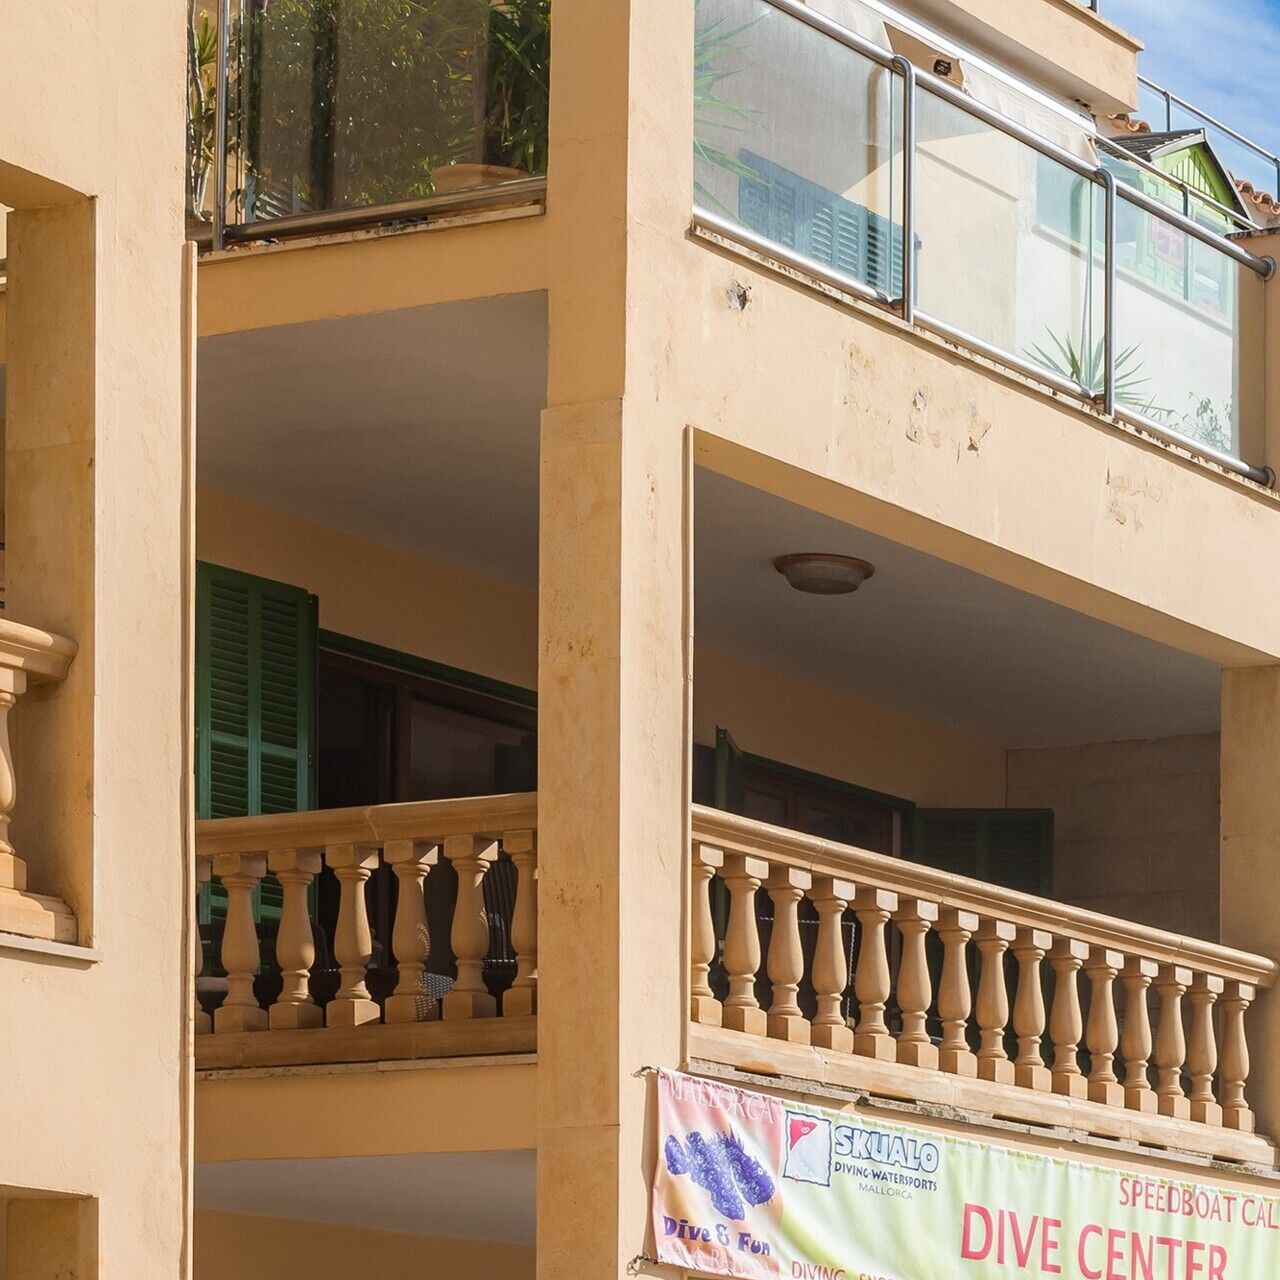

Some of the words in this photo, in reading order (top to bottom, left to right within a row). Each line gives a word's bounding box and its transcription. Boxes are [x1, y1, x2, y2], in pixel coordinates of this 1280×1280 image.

[834, 1125, 940, 1174] SKUALO
[858, 1182, 914, 1200] MALLORCA
[1118, 1177, 1238, 1223] SPEEDBOAT
[663, 1215, 712, 1243] Dive
[715, 1223, 730, 1247] &
[737, 1232, 771, 1256] Fun
[961, 1202, 1063, 1275] DIVE
